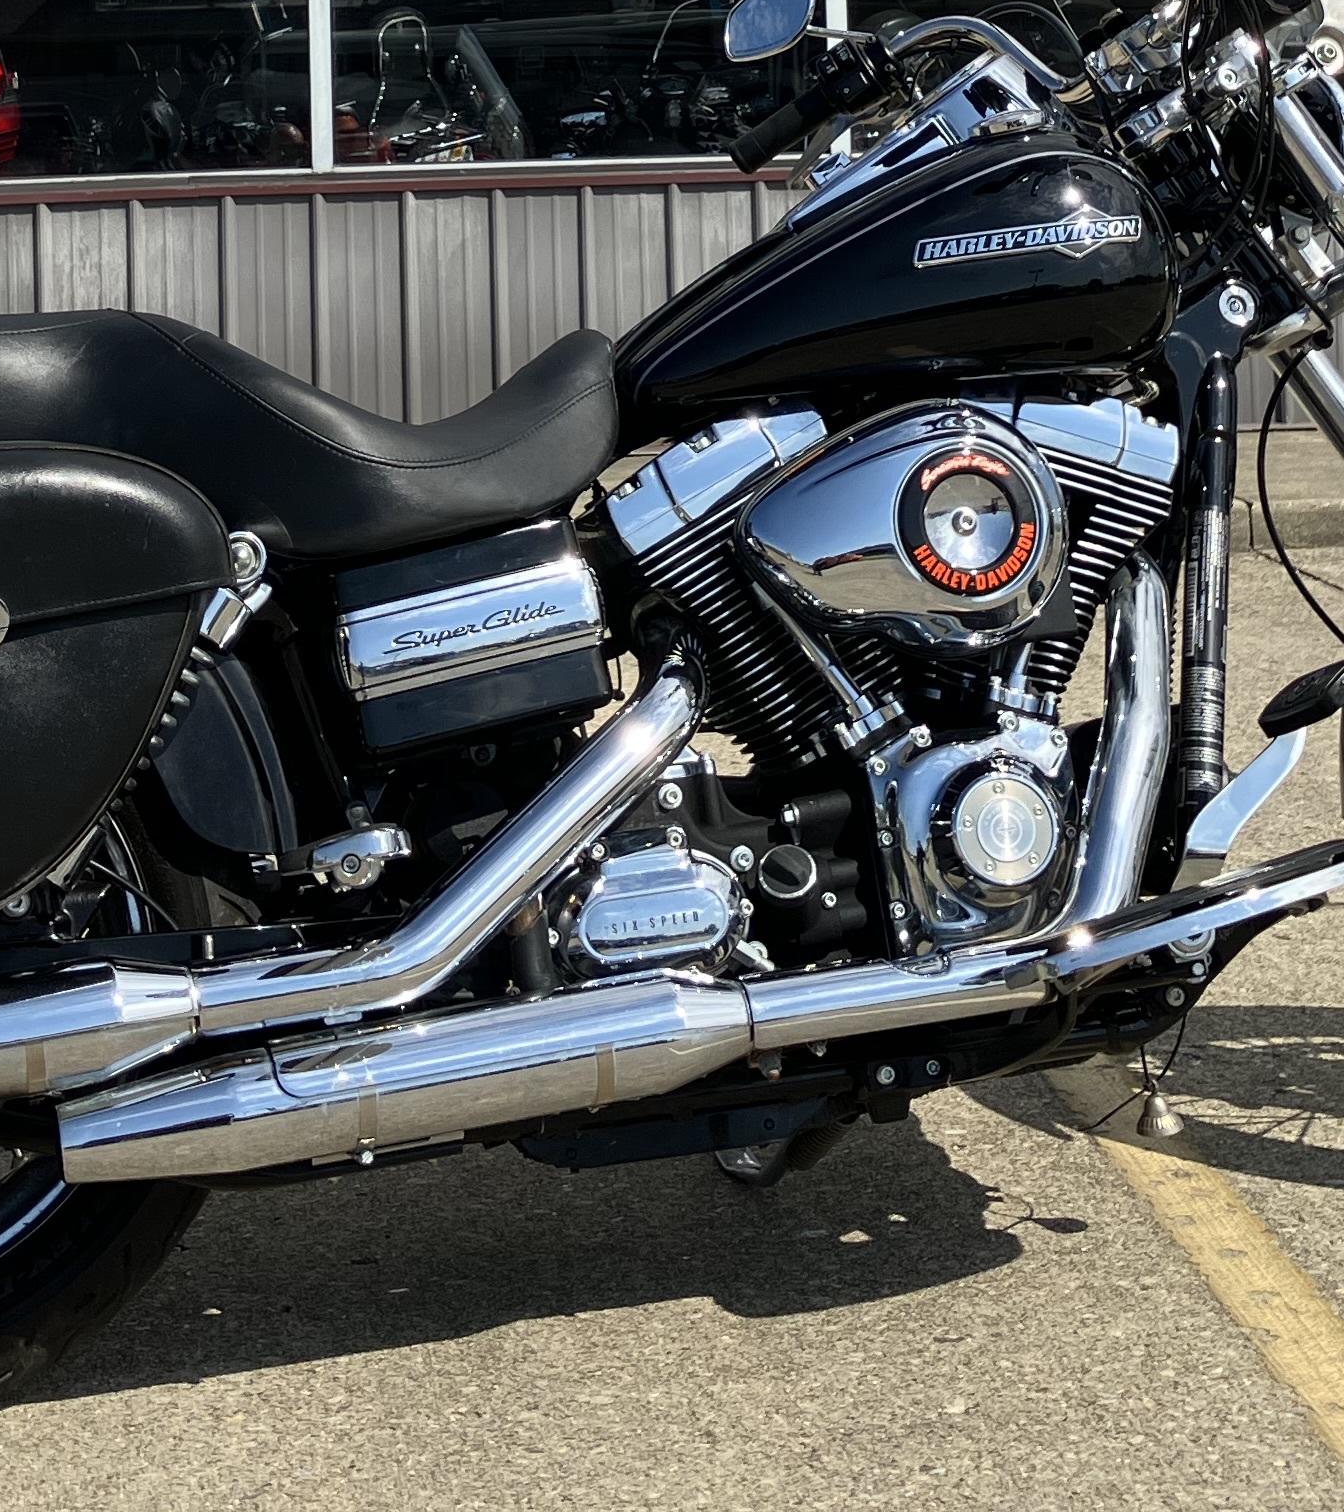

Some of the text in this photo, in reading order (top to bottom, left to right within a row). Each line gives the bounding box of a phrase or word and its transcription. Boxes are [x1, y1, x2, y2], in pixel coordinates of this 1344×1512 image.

[922, 218, 1138, 259] HARLEY-DAVIDSON
[384, 601, 566, 654] Super Glide
[612, 910, 699, 935] SIX SPEED
